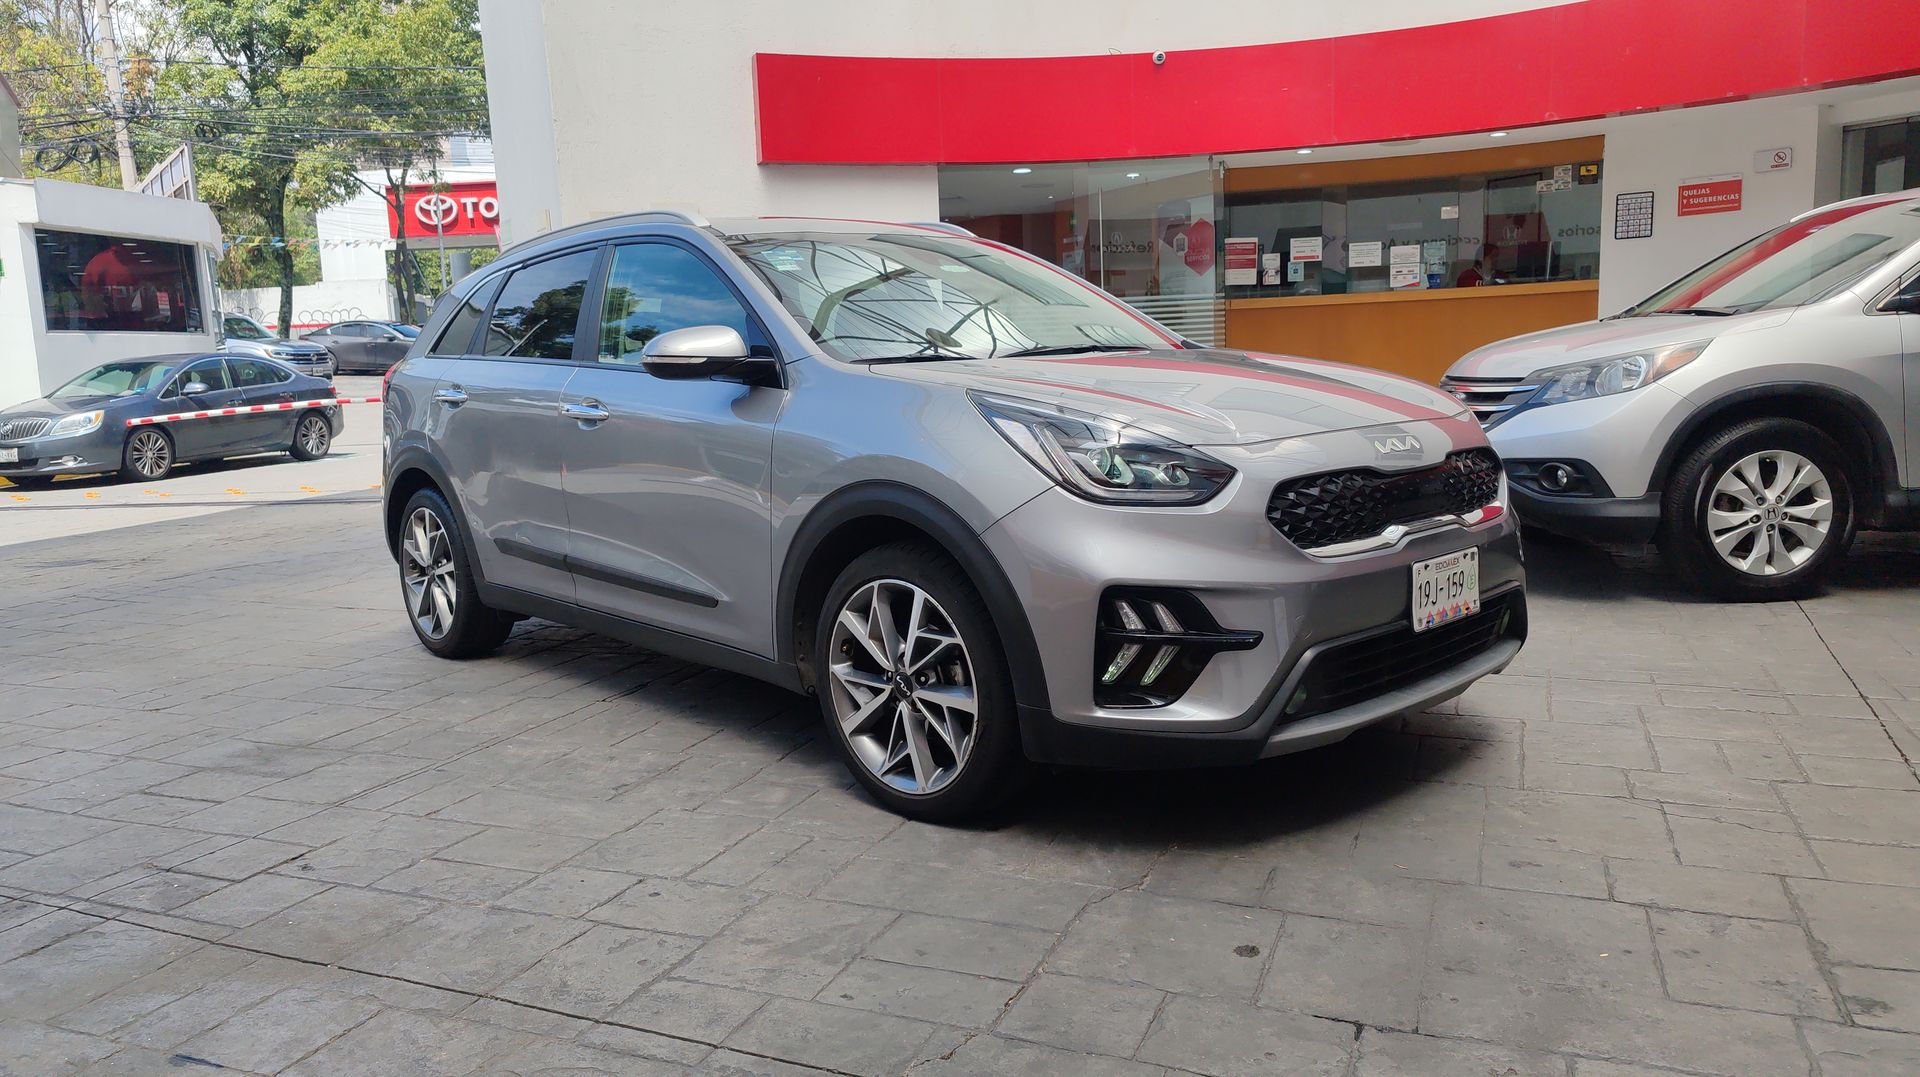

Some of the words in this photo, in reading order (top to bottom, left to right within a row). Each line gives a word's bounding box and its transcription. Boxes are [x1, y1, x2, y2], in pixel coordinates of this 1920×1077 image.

[1683, 188, 1710, 197] QUEJAS
[1690, 194, 1740, 204] SUGERENCIAS
[461, 197, 499, 218] TO
[1418, 570, 1465, 609] 19J-159
